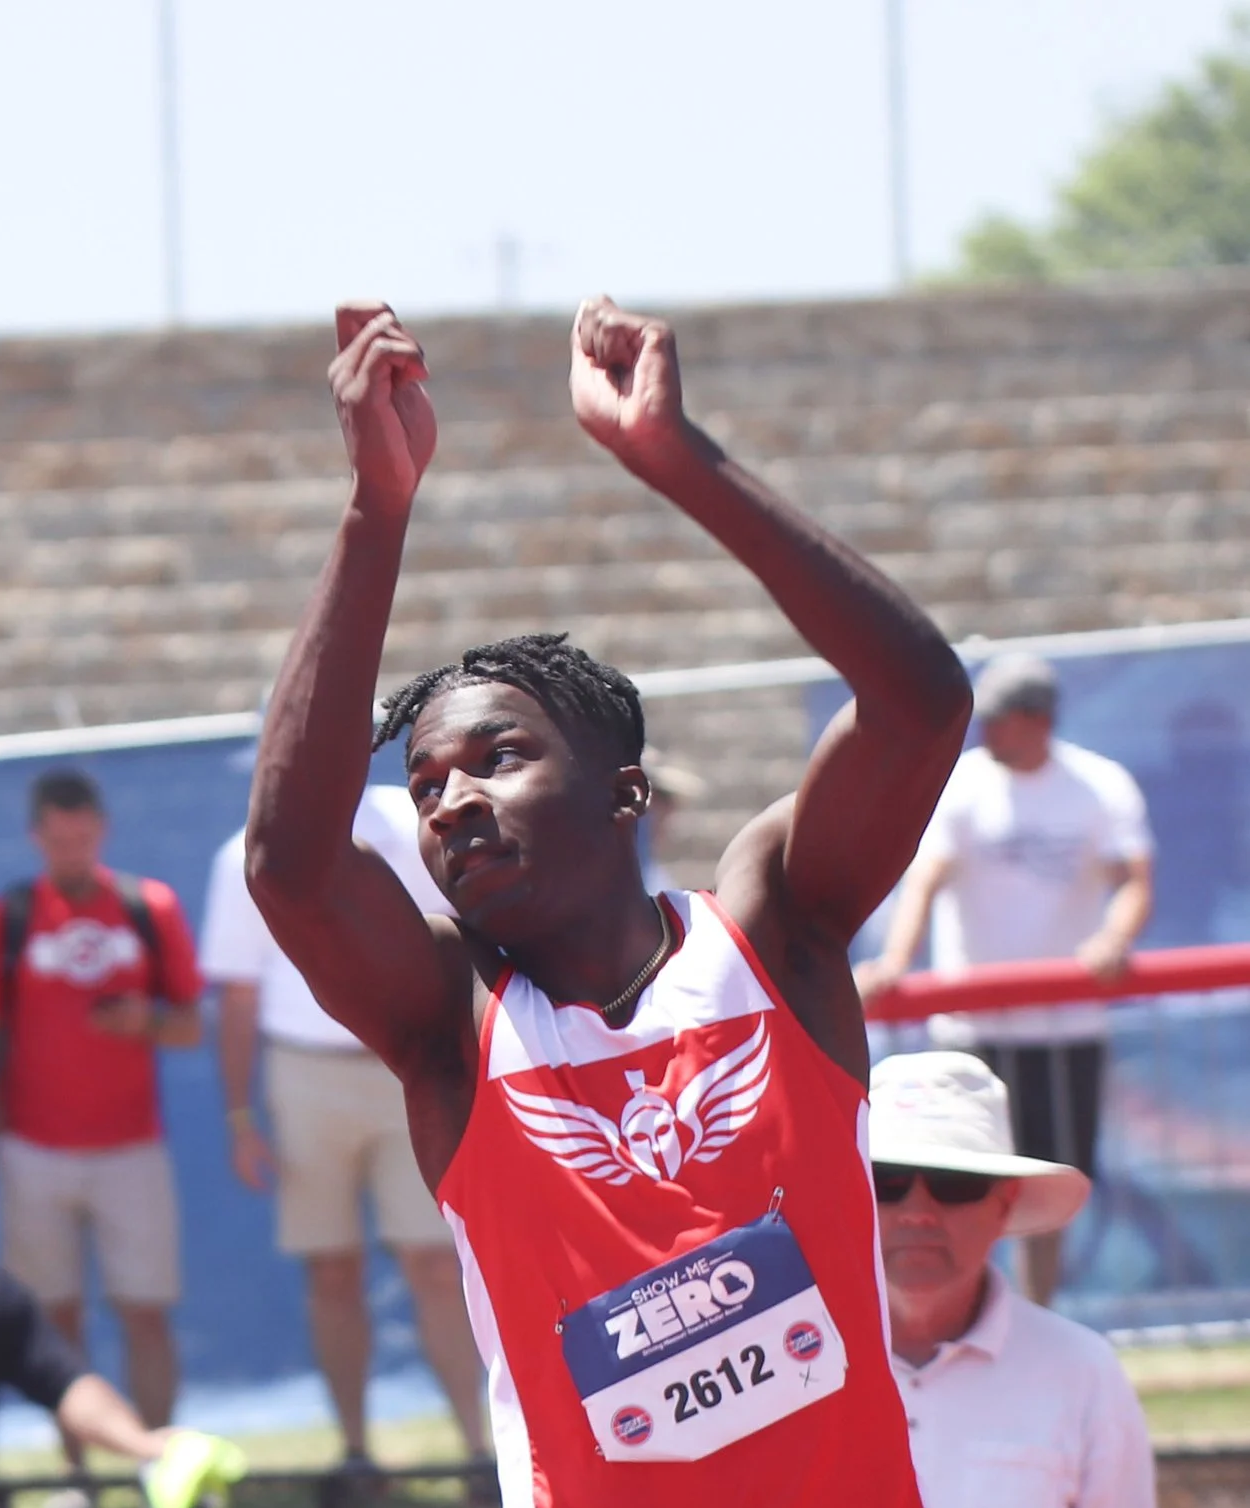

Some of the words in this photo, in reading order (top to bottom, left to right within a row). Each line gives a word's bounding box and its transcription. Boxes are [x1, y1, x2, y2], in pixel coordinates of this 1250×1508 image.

[604, 1259, 755, 1361] ZERO
[631, 1257, 711, 1306] SHOW-ME
[663, 1344, 775, 1424] 2612
